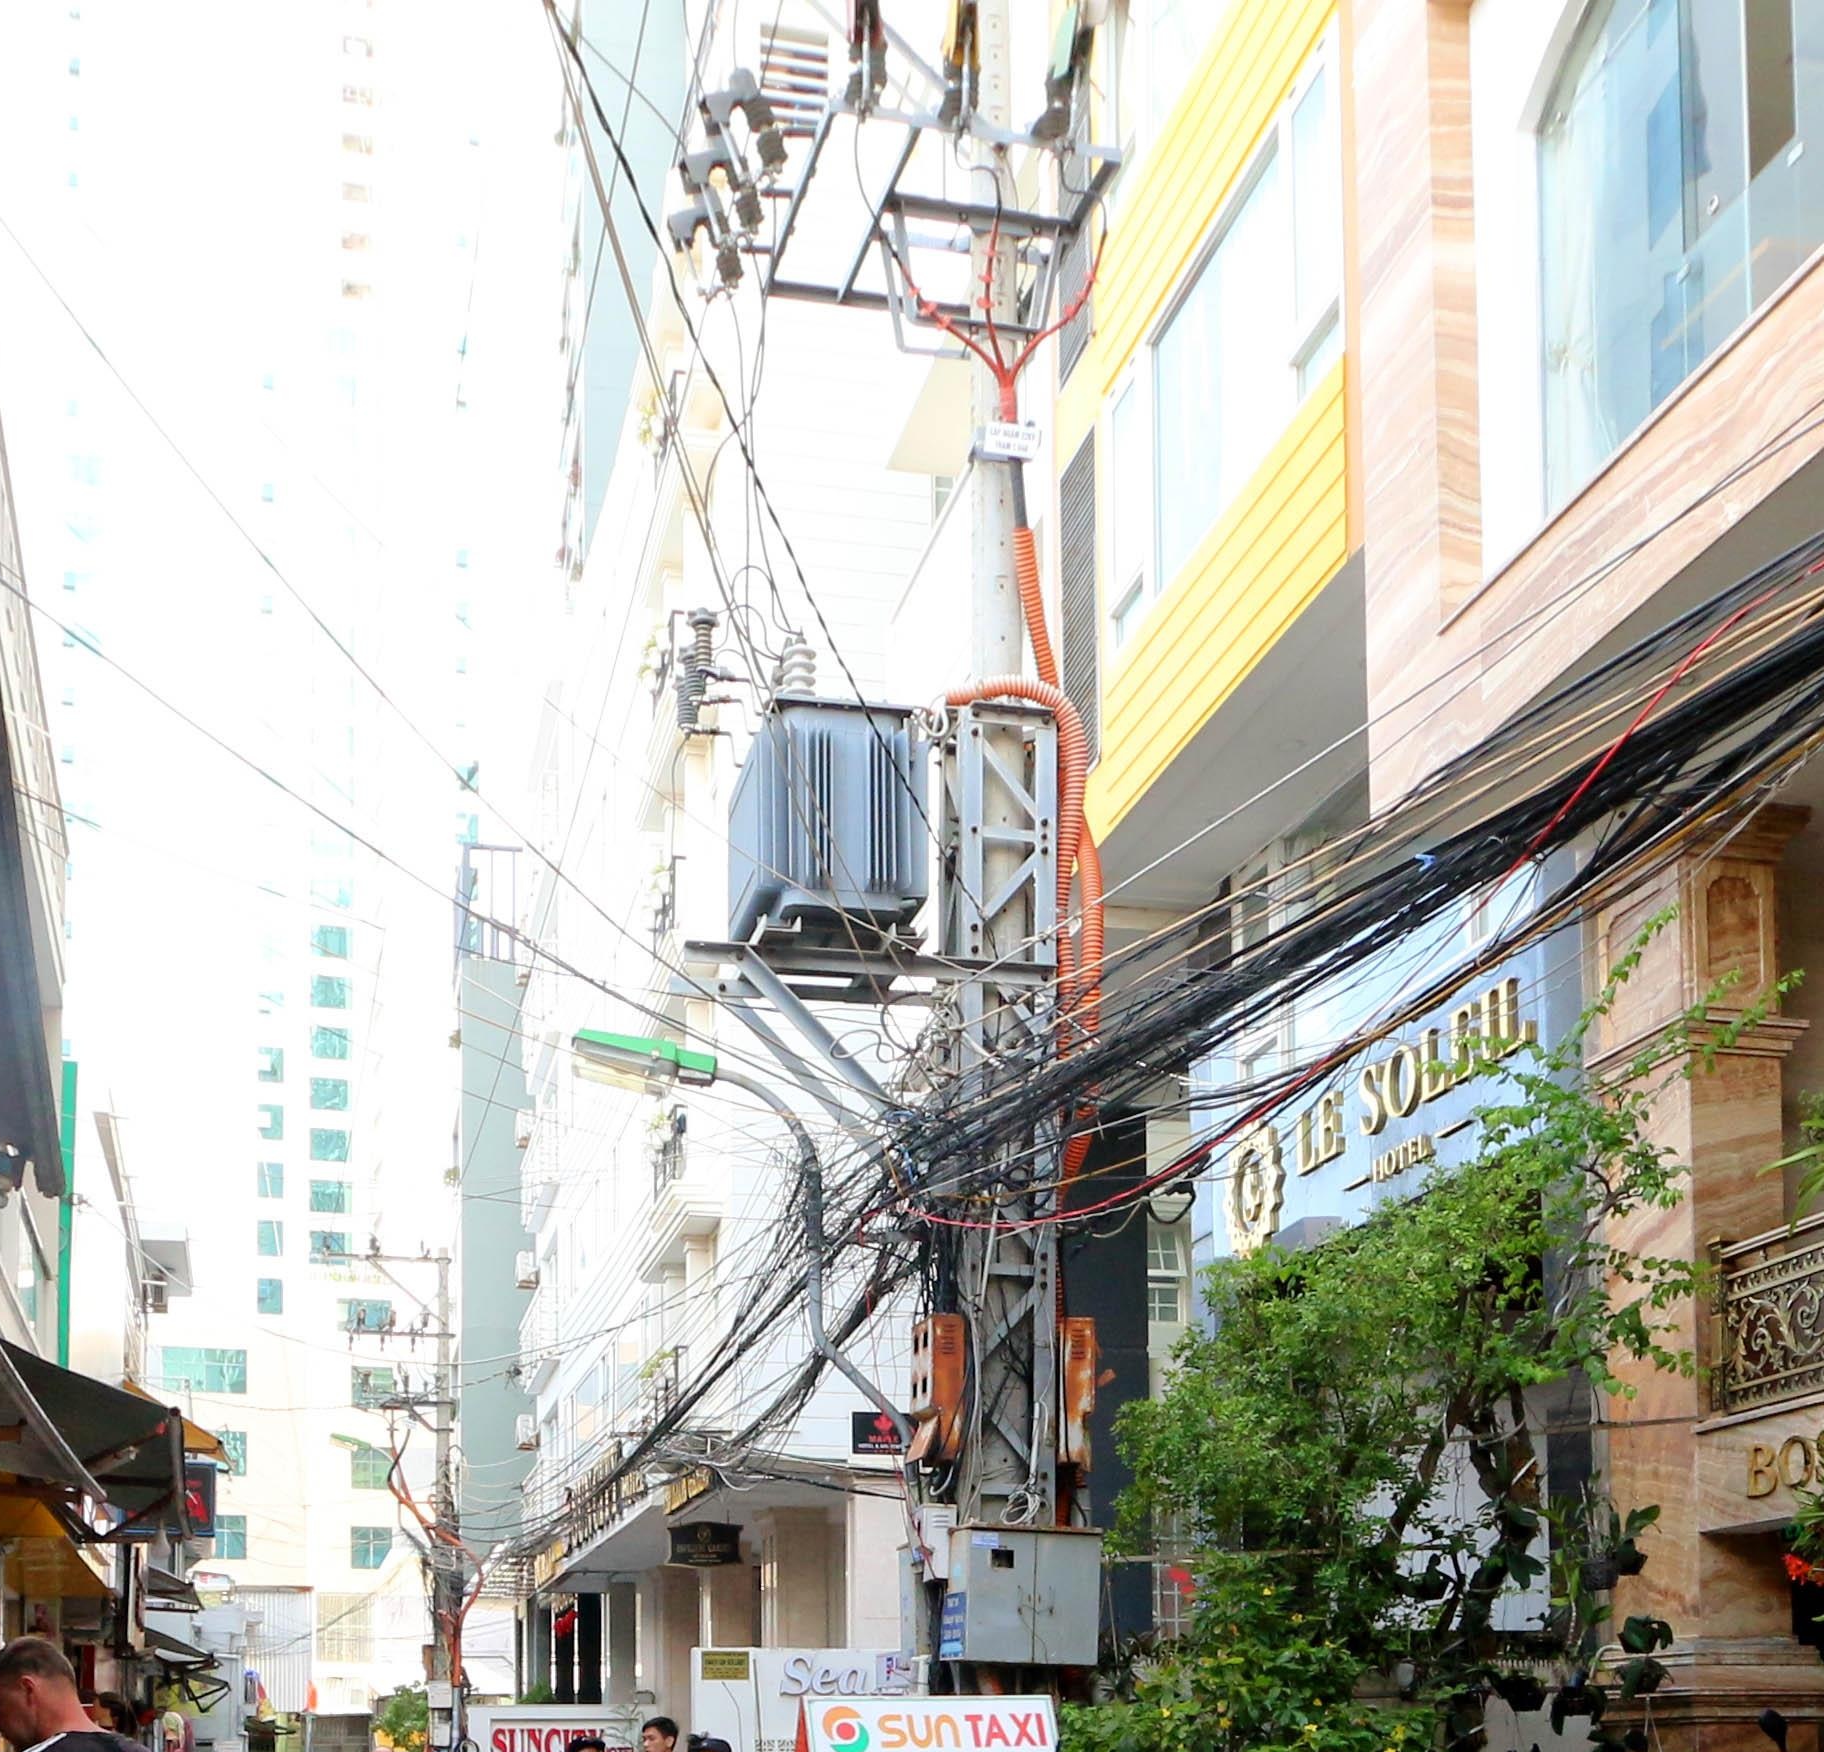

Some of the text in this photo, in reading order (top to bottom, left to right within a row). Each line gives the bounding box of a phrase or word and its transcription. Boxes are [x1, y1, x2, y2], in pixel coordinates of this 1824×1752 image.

[1297, 977, 1539, 1177] LE SOLEIL
[1372, 1133, 1436, 1184] HOTEL
[779, 1657, 868, 1697] Sea
[963, 1713, 1048, 1748] TAXI
